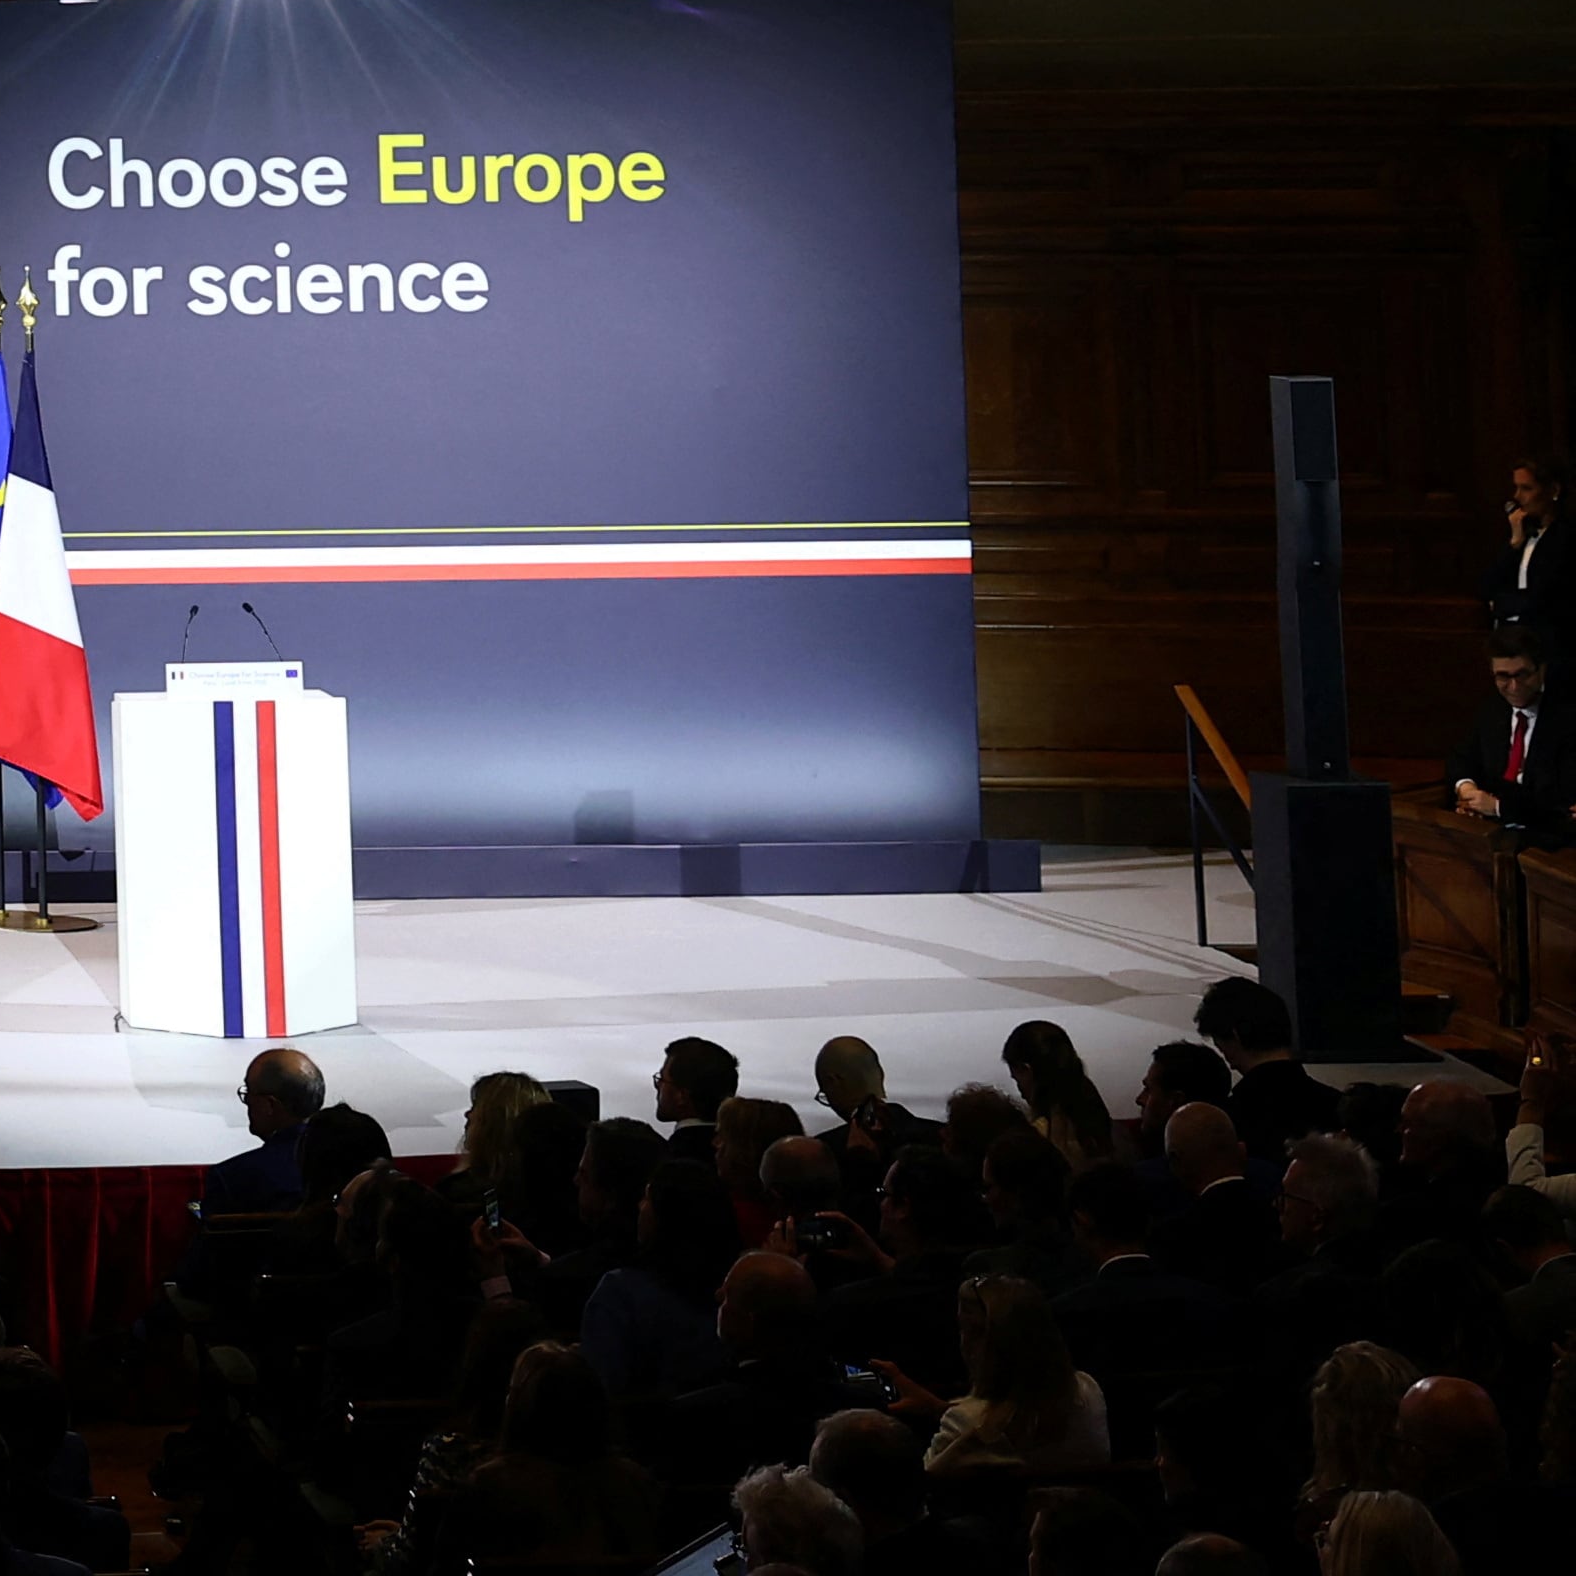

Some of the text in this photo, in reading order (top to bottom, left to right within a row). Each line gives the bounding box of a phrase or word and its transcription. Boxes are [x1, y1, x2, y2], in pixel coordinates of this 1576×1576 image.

[48, 133, 665, 223] Choose Europe
[48, 242, 489, 317] for science
